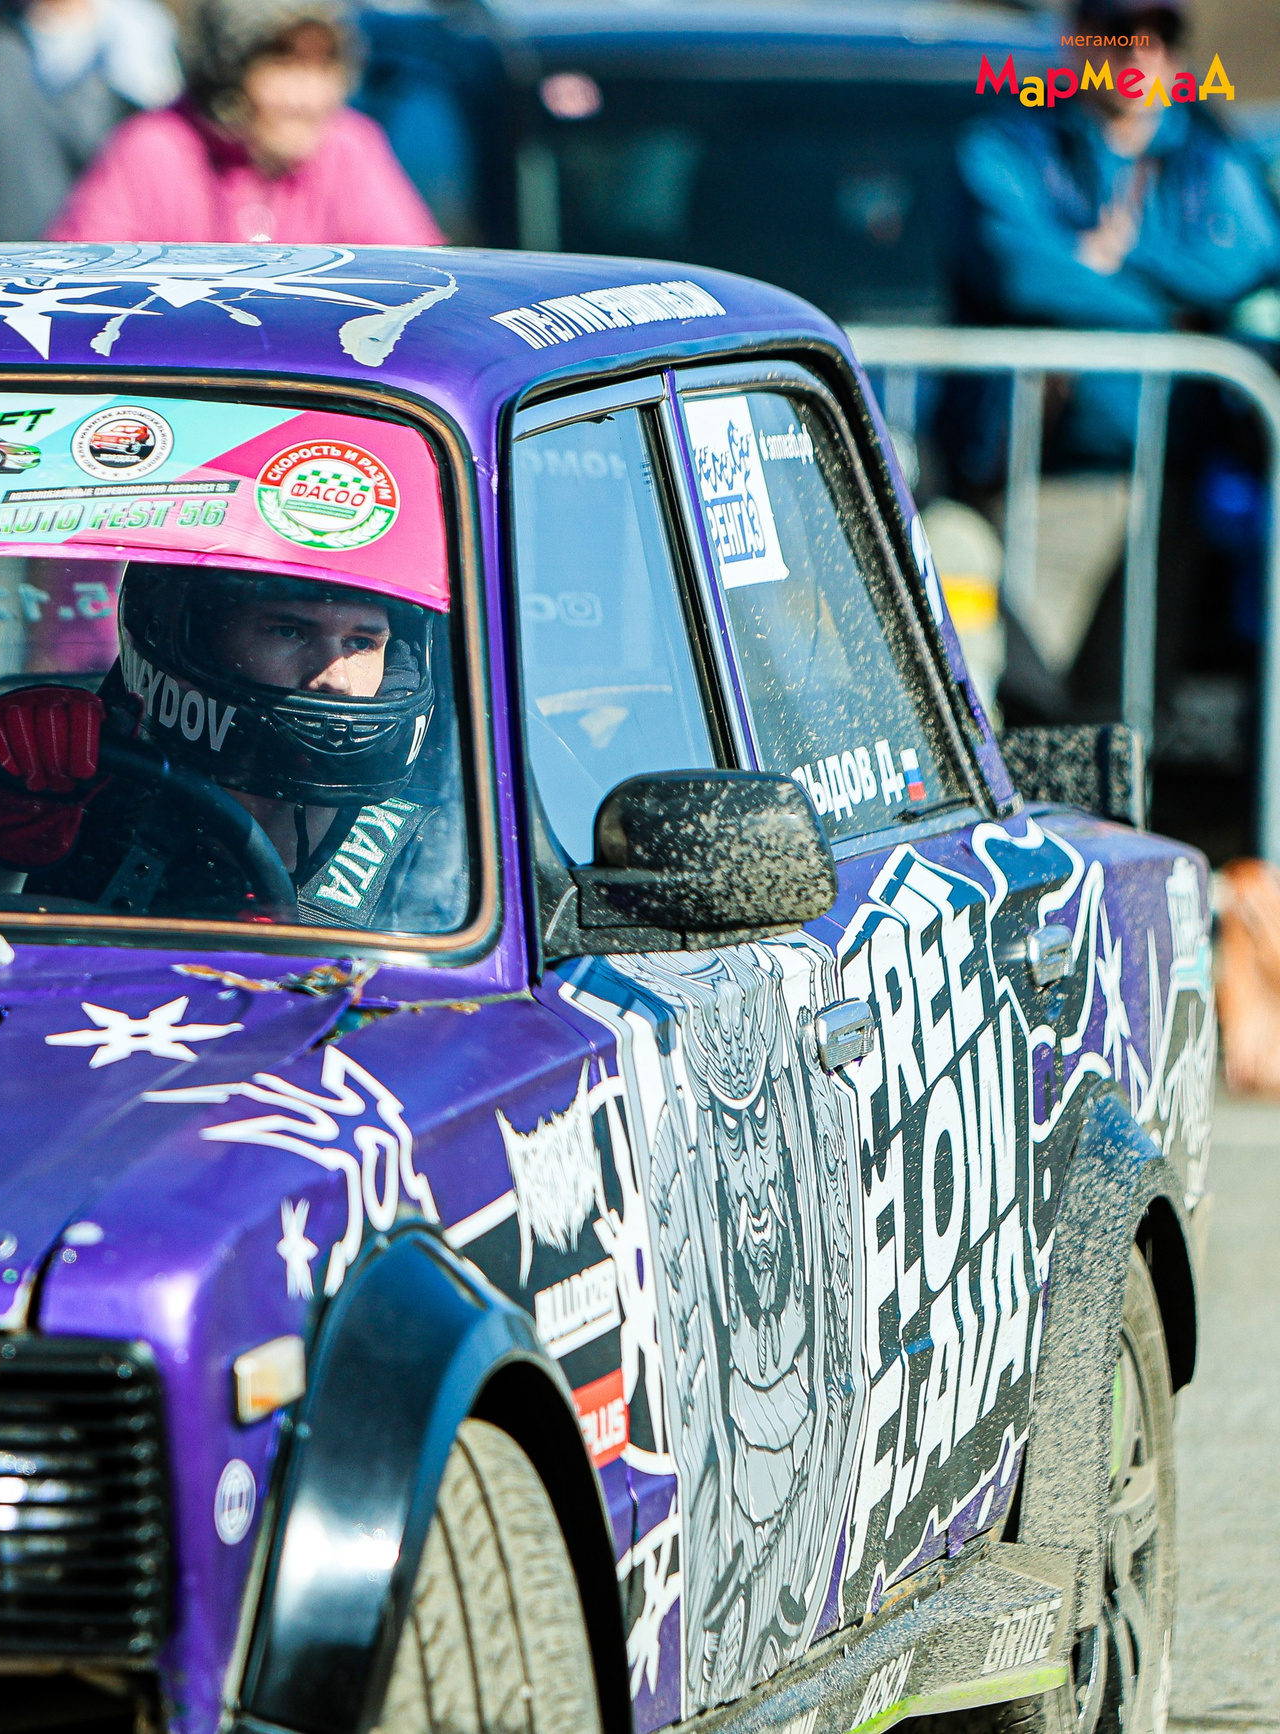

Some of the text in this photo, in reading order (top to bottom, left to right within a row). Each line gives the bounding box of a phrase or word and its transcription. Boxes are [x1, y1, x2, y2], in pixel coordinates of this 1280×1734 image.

[266, 445, 393, 501] СКОРОСТЬ И РАЗУМ
[290, 483, 366, 507] ФАСОО
[88, 500, 175, 530] FEST
[175, 499, 229, 528] 56
[874, 738, 906, 807] Д.
[862, 1001, 1017, 1379] FLOW
[844, 1203, 1028, 1578] FLAVA
